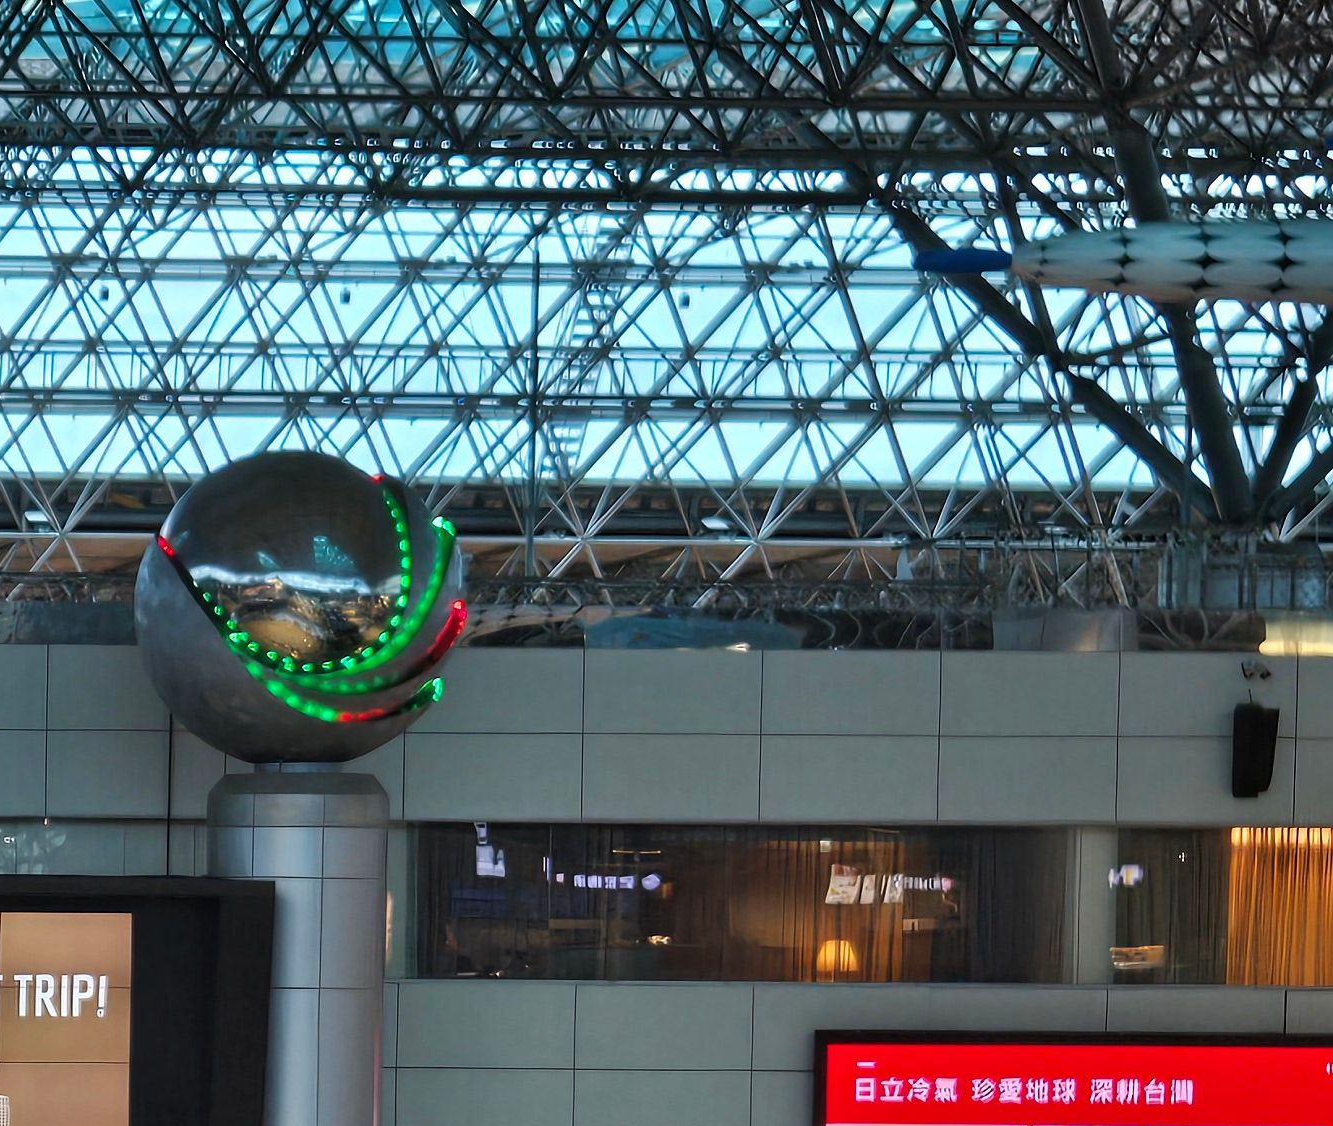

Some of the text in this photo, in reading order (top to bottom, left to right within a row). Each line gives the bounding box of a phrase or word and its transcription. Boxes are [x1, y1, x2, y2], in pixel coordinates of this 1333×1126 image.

[13, 973, 108, 1019] TRIP!
[854, 1077, 958, 1102] 日立冷氣
[971, 1077, 1076, 1104] 珍愛地球
